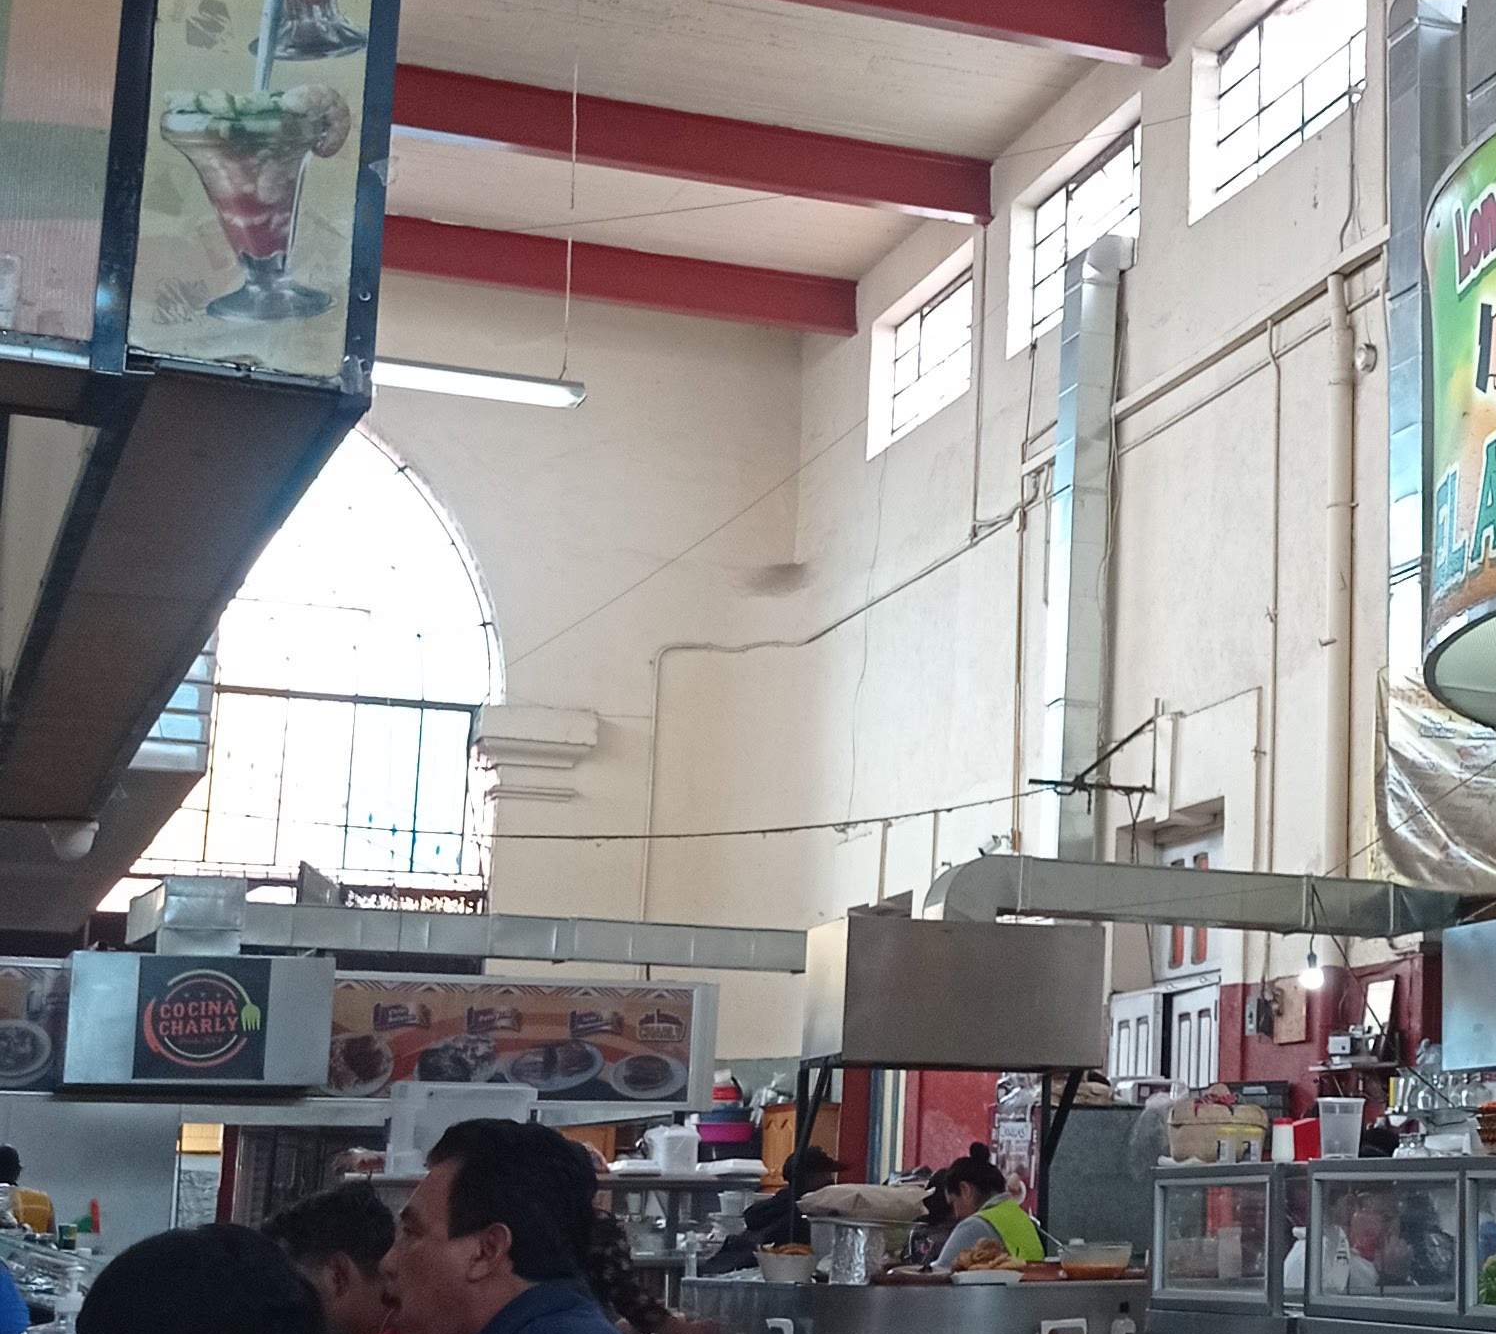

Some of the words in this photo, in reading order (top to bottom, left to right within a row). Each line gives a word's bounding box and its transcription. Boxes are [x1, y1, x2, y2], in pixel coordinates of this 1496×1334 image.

[1433, 468, 1468, 595] EL
[160, 999, 237, 1018] COCINA
[158, 1017, 239, 1036] CHARLY
